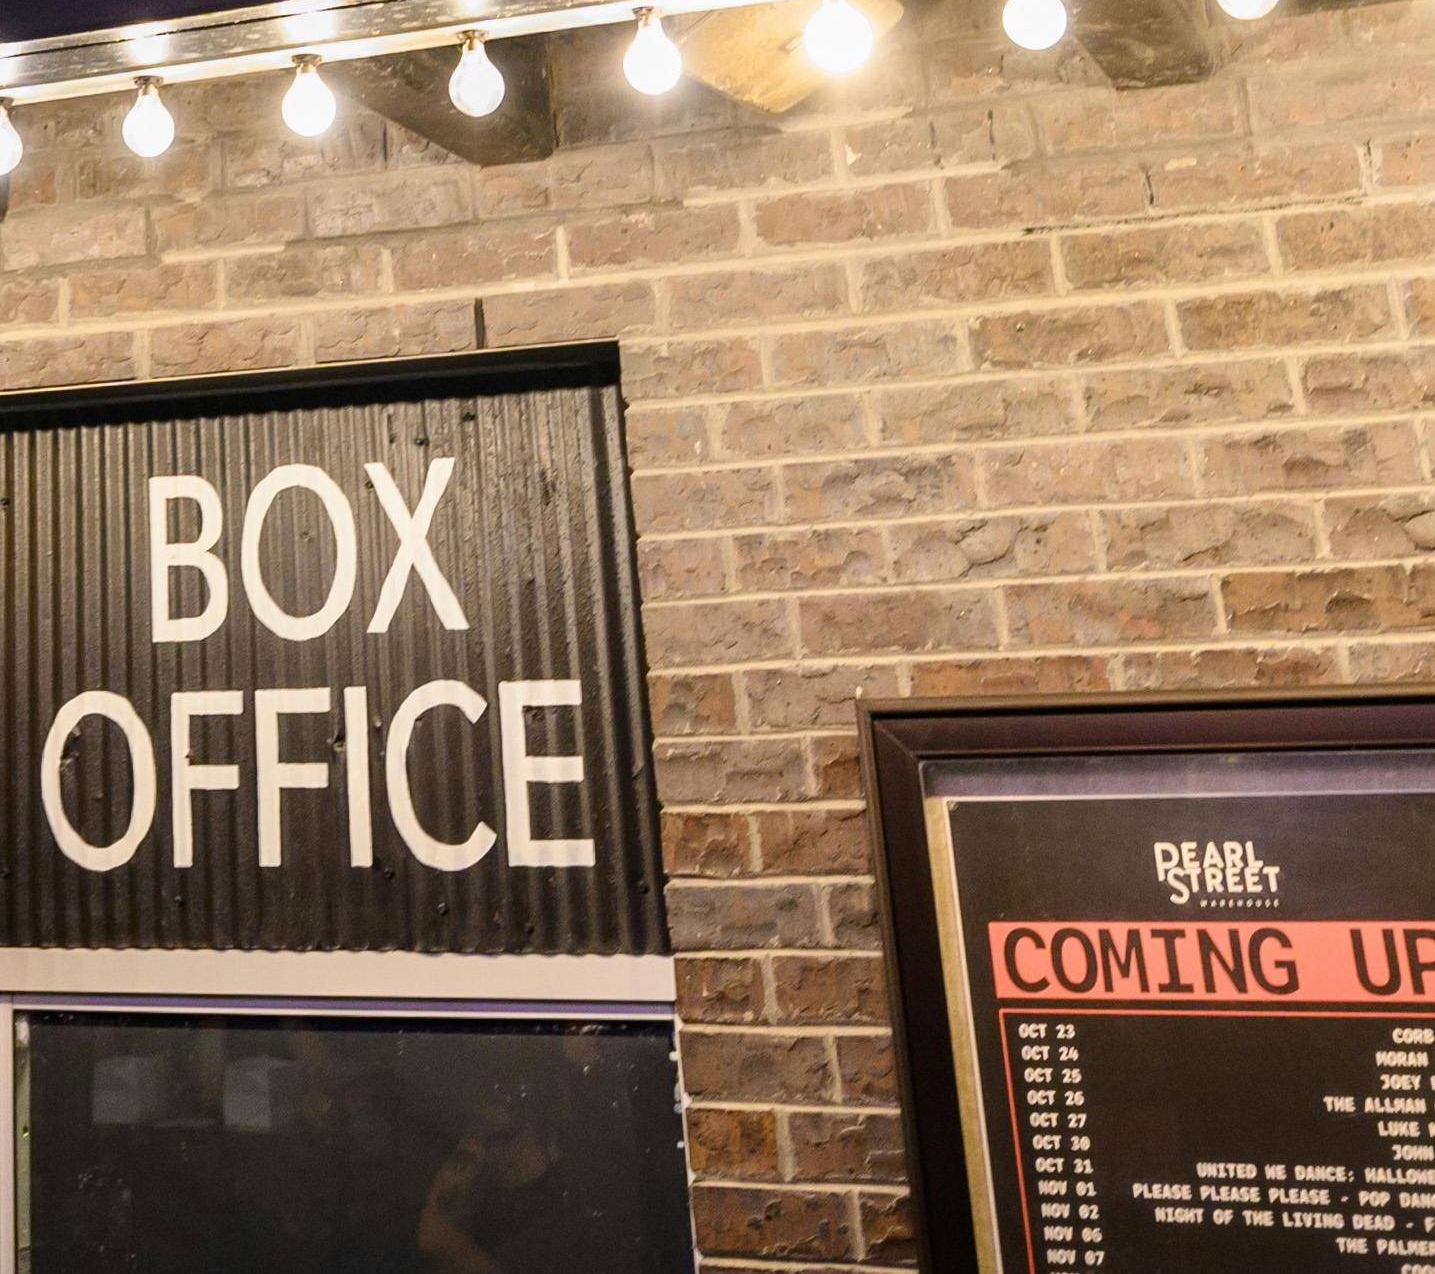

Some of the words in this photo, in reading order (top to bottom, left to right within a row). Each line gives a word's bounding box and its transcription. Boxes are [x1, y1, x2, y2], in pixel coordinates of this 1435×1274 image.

[149, 456, 469, 643] BOX
[41, 679, 595, 872] OFFICE
[1153, 840, 1263, 883] PEARL
[1166, 865, 1280, 905] STREET
[1003, 926, 1300, 995] COMING
[1019, 1023, 1047, 1038] OCT
[1056, 1024, 1075, 1039] 23
[1392, 1028, 1435, 1044] CORB
[1021, 1045, 1050, 1060] OCT
[1059, 1046, 1079, 1061] 24
[1024, 1068, 1053, 1082] OCT
[1062, 1069, 1082, 1083] 25
[1380, 1074, 1421, 1090] JOEY
[1027, 1090, 1056, 1105] OCT
[1065, 1091, 1084, 1105] 26
[1323, 1096, 1356, 1112] THE
[1030, 1112, 1058, 1127] OCT
[1068, 1113, 1086, 1128] 27
[1378, 1121, 1421, 1137] LUKE
[1033, 1135, 1061, 1150] OCT
[1071, 1136, 1090, 1151] 30
[1392, 1144, 1435, 1161] JOHN
[1035, 1157, 1064, 1172] OCT
[1074, 1159, 1093, 1173] 31
[1196, 1162, 1257, 1179] UNITED
[1294, 1165, 1354, 1182] DANCE:
[1038, 1180, 1067, 1195] NOV
[1076, 1181, 1096, 1196] 01
[1132, 1183, 1192, 1200] PLEASE
[1200, 1185, 1260, 1202] PLEASE
[1268, 1188, 1330, 1205] PLEASE
[1359, 1191, 1391, 1207] POP
[1041, 1203, 1070, 1218] NOV
[1079, 1204, 1099, 1219] 02
[1155, 1207, 1204, 1223] NIGHT
[1213, 1209, 1233, 1224] OF
[1242, 1210, 1274, 1226] THE
[1282, 1212, 1344, 1229] LIVING
[1352, 1214, 1395, 1231] DEAD
[1044, 1226, 1073, 1241] NOV
[1082, 1228, 1102, 1242] 06
[1336, 1237, 1368, 1254] THE
[1047, 1249, 1076, 1264] NOV
[1085, 1251, 1104, 1265] 07
